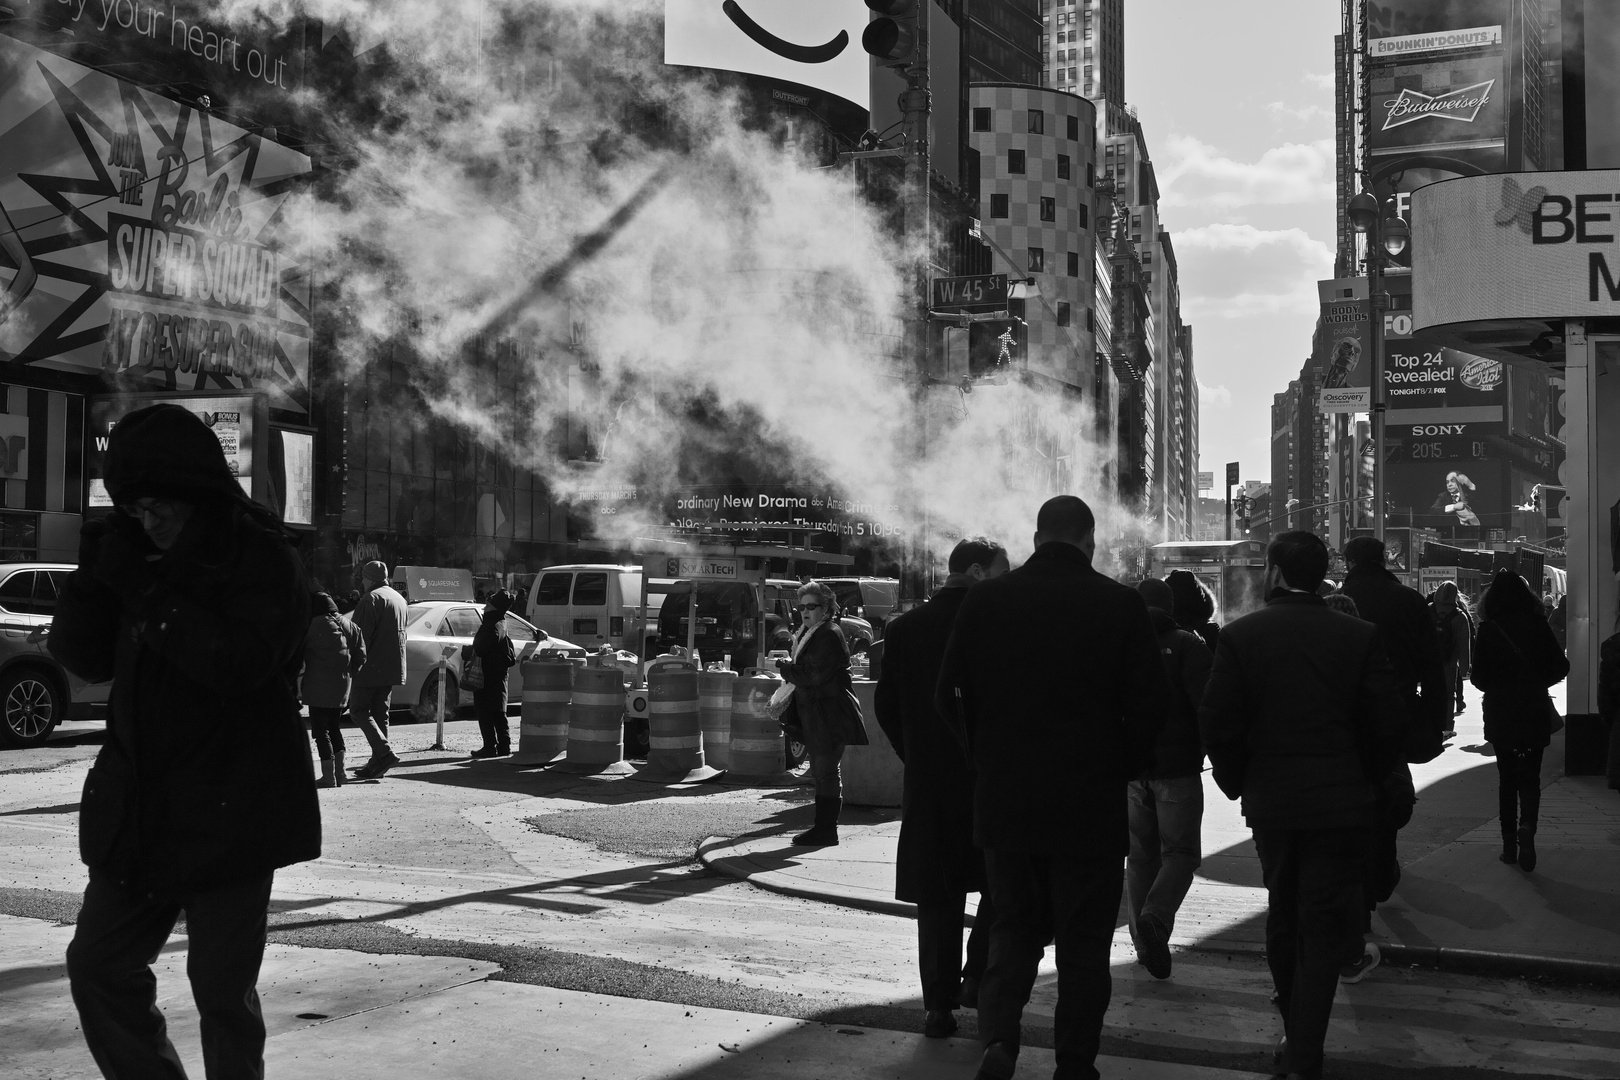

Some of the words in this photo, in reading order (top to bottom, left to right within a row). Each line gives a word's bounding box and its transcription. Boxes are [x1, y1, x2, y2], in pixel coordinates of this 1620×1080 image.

[97, 0, 164, 38] your
[171, 5, 241, 71] heart
[247, 49, 287, 90] out
[1438, 31, 1488, 46] DONUTS
[774, 90, 808, 105] OUTFRONT
[1384, 94, 1489, 117] Budweiser
[108, 132, 140, 169] JOIN
[120, 169, 145, 206] THE
[151, 145, 247, 238] Barbie
[1533, 194, 1620, 244] BE
[111, 223, 196, 298] SUPER
[198, 239, 274, 308] SQUAD
[940, 281, 955, 302] W
[962, 280, 982, 301] 45
[989, 276, 1000, 289] St
[1324, 313, 1368, 323] WORLDS
[1331, 306, 1360, 315] BODY
[1384, 315, 1412, 336] FO
[1391, 353, 1419, 369] Top
[1423, 352, 1443, 366] 24
[1384, 367, 1454, 383] Revealed!
[1476, 368, 1500, 386] Idol
[1325, 394, 1363, 402] Discovery
[1412, 424, 1467, 436] SONY
[1412, 442, 1442, 458] 2015
[578, 491, 610, 501] THURSDAY
[611, 490, 632, 500] MARCH
[632, 490, 637, 500] 5
[723, 494, 754, 508] New
[758, 493, 807, 508] Drama
[845, 500, 882, 514] Crime
[601, 505, 616, 514] abc
[856, 523, 864, 536] 5
